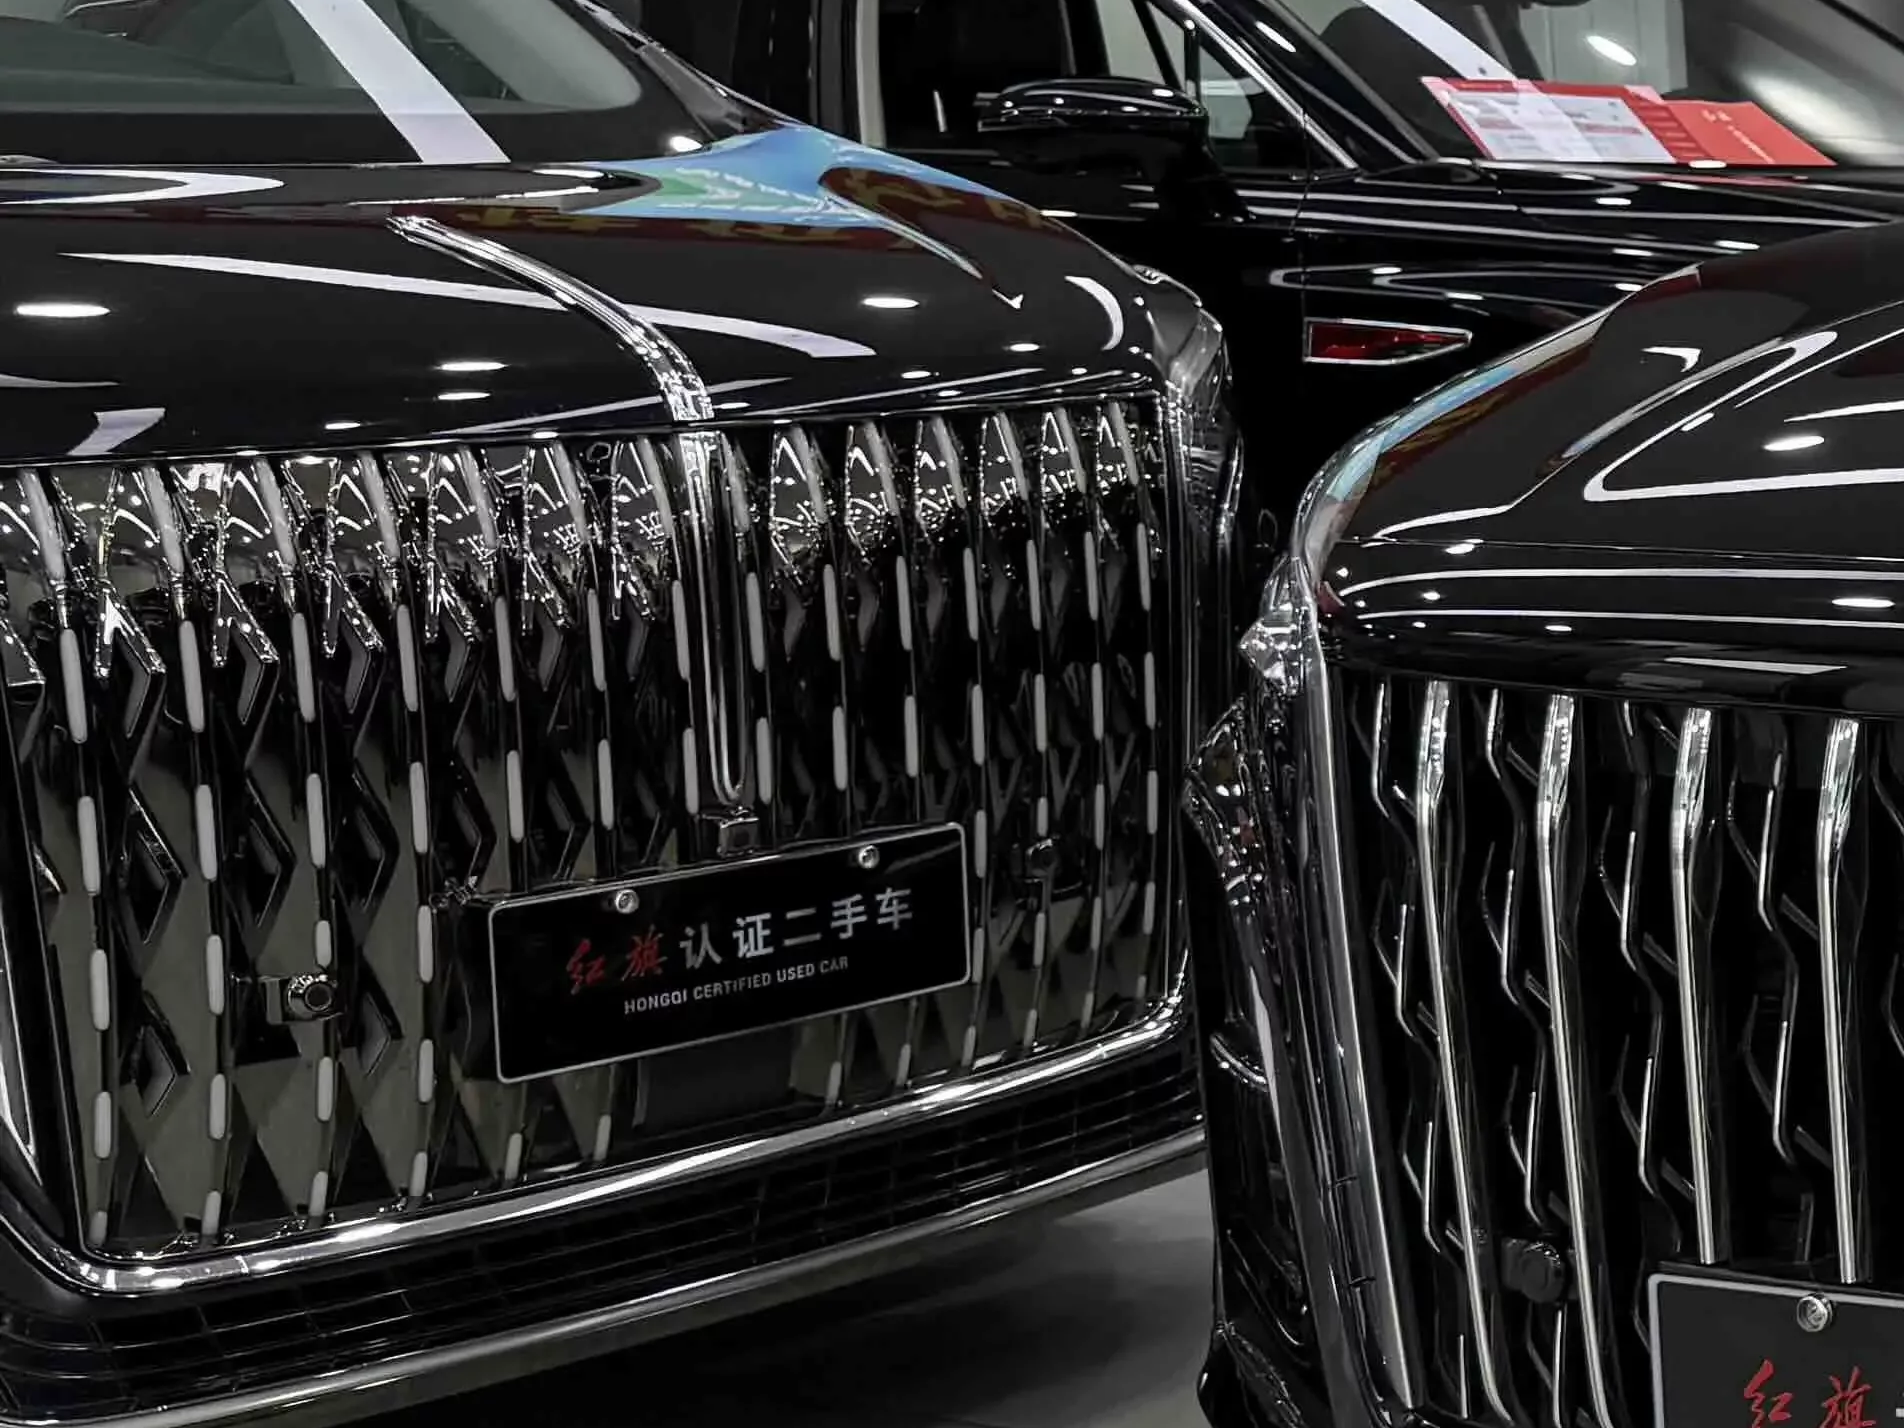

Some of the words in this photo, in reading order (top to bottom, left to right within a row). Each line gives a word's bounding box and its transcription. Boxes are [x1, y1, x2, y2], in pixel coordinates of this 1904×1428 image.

[624, 989, 688, 1015] HONGQI
[693, 972, 772, 1001] CERTIFIED
[776, 963, 815, 984] USED
[820, 955, 849, 974] CAR
